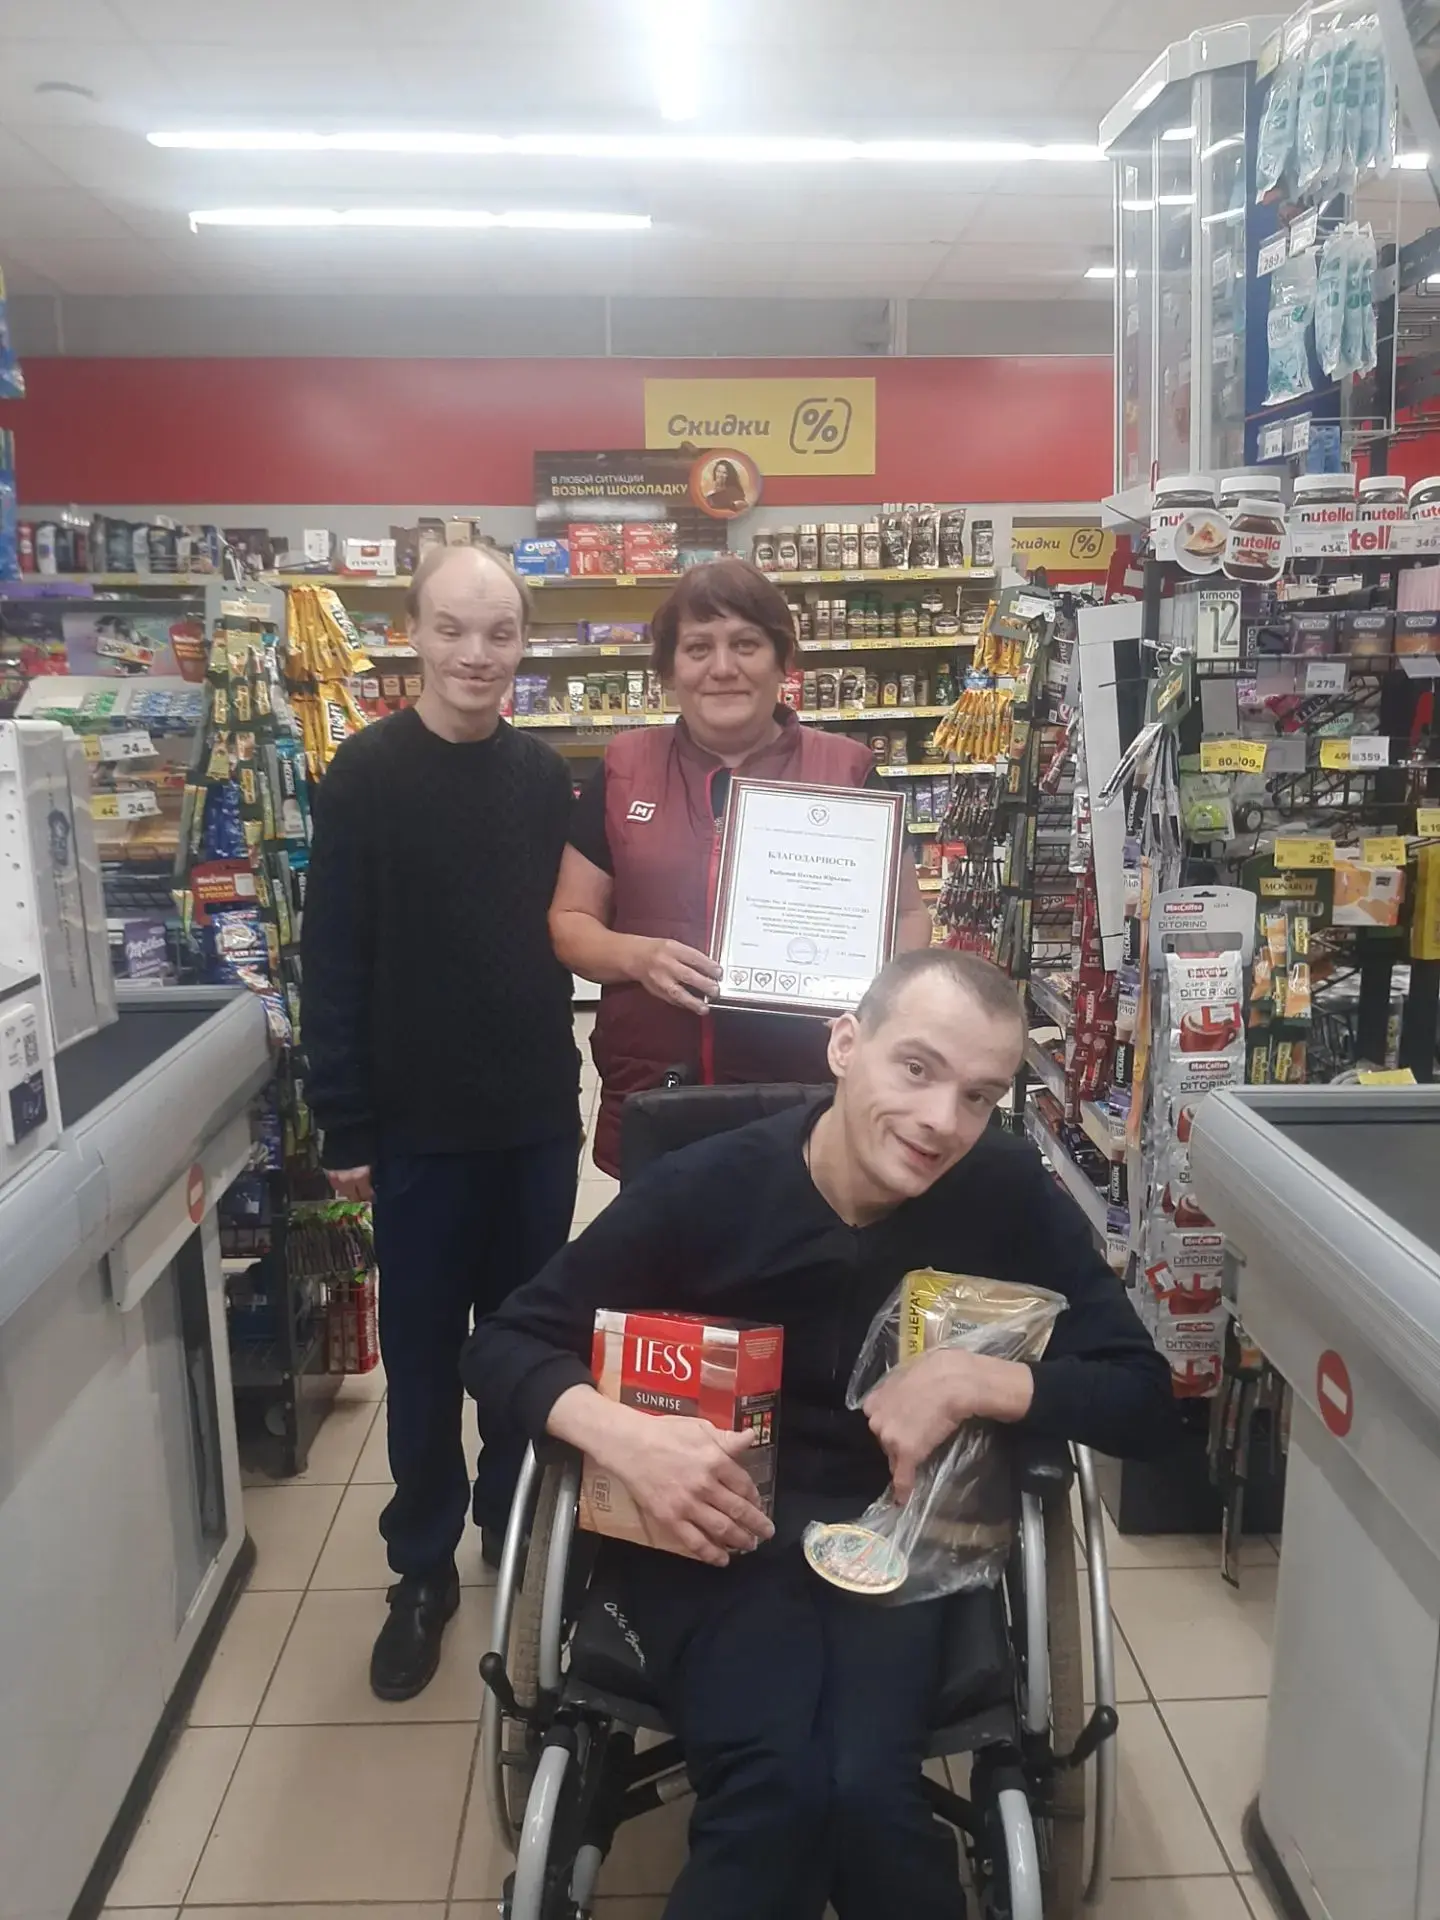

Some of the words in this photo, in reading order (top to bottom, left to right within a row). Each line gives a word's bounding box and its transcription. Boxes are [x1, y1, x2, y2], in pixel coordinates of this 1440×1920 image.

[667, 414, 770, 437] Скидки
[559, 474, 593, 484] ЛЮБОЙ
[595, 474, 645, 484] СИТУАЦИИ
[552, 486, 605, 496] ВОЗЬМИ
[607, 484, 688, 496] ШОКОЛАДКУ
[1301, 507, 1353, 523] nutella
[1232, 536, 1281, 551] nutella
[1200, 590, 1240, 600] kimono
[1207, 600, 1239, 653] 12
[1218, 758, 1233, 767] 80
[1360, 753, 1380, 762] 359
[768, 851, 857, 867] БЛАГОДАРНОСТЬ
[1263, 883, 1314, 895] MONARCH
[1165, 903, 1203, 912] MacCoffee
[1158, 921, 1207, 929] DITORINO
[1191, 1062, 1229, 1070] MacCoffee
[1173, 1255, 1223, 1265] DITORIN
[636, 1390, 682, 1412] SUNRISE
